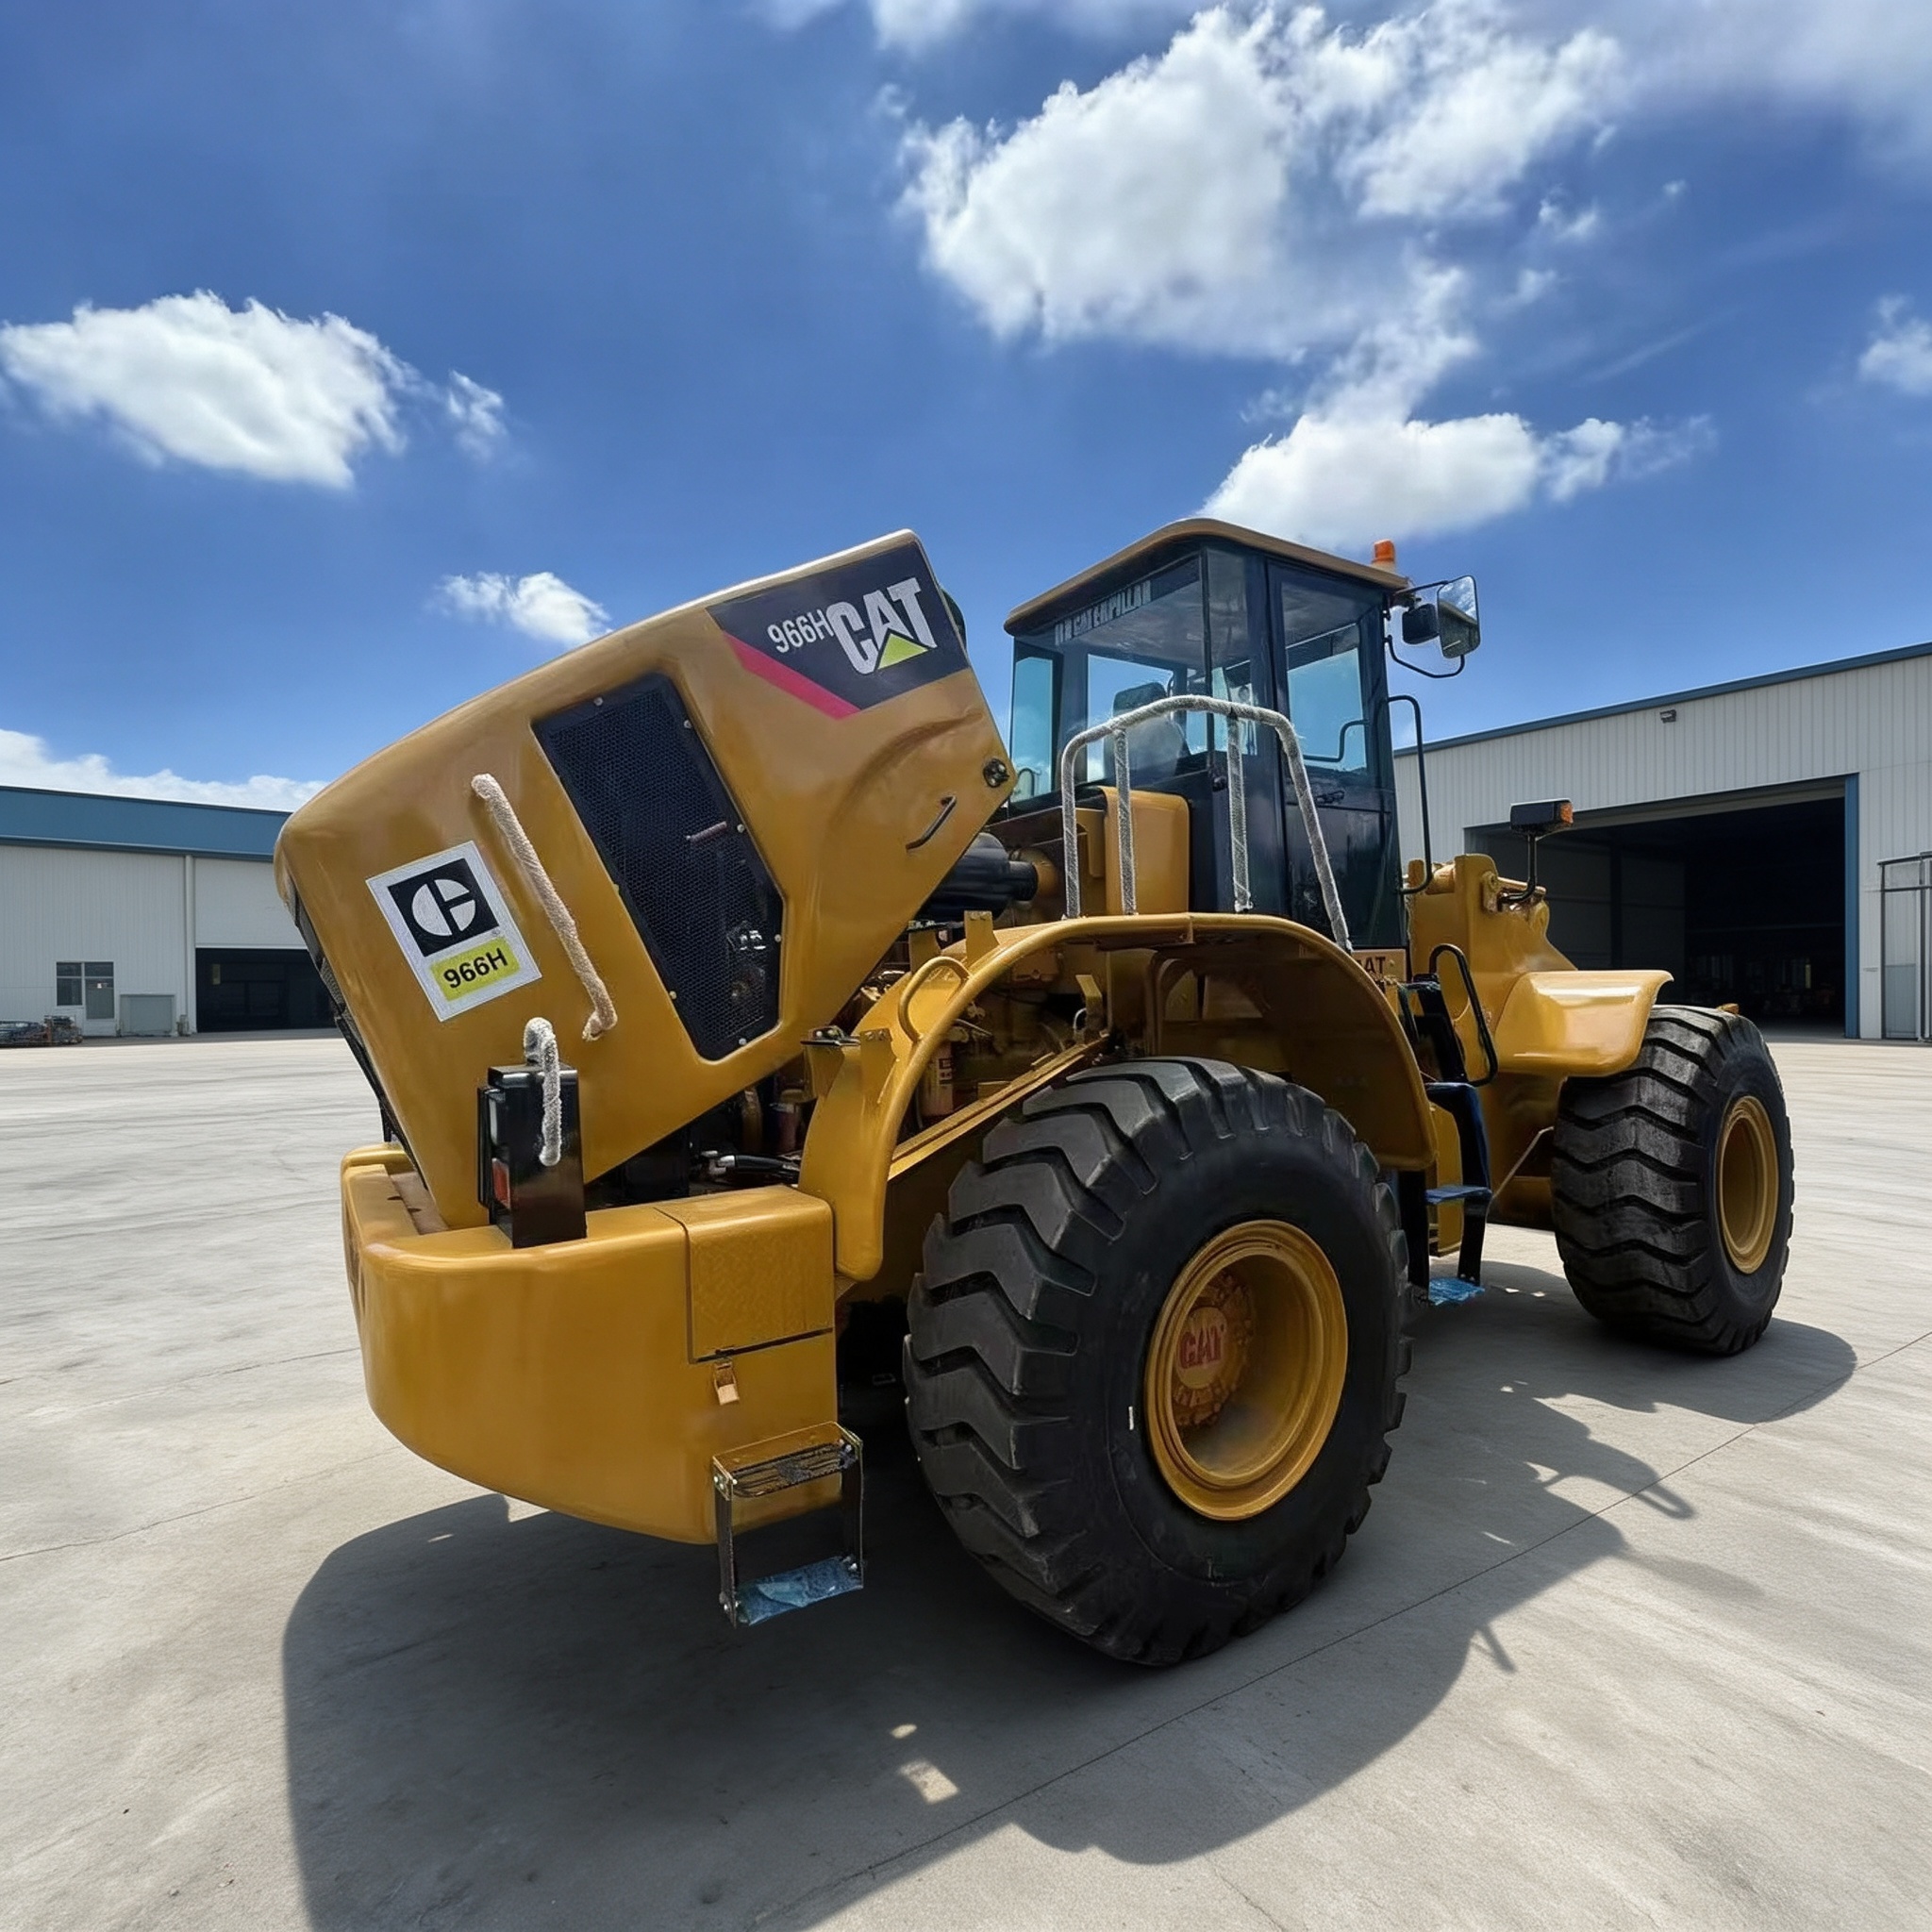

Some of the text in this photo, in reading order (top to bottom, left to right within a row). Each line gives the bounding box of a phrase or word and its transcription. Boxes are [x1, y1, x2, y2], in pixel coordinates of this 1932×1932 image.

[767, 577, 938, 675] 966H CAT
[443, 948, 508, 989] 966H
[1356, 956, 1386, 974] AT
